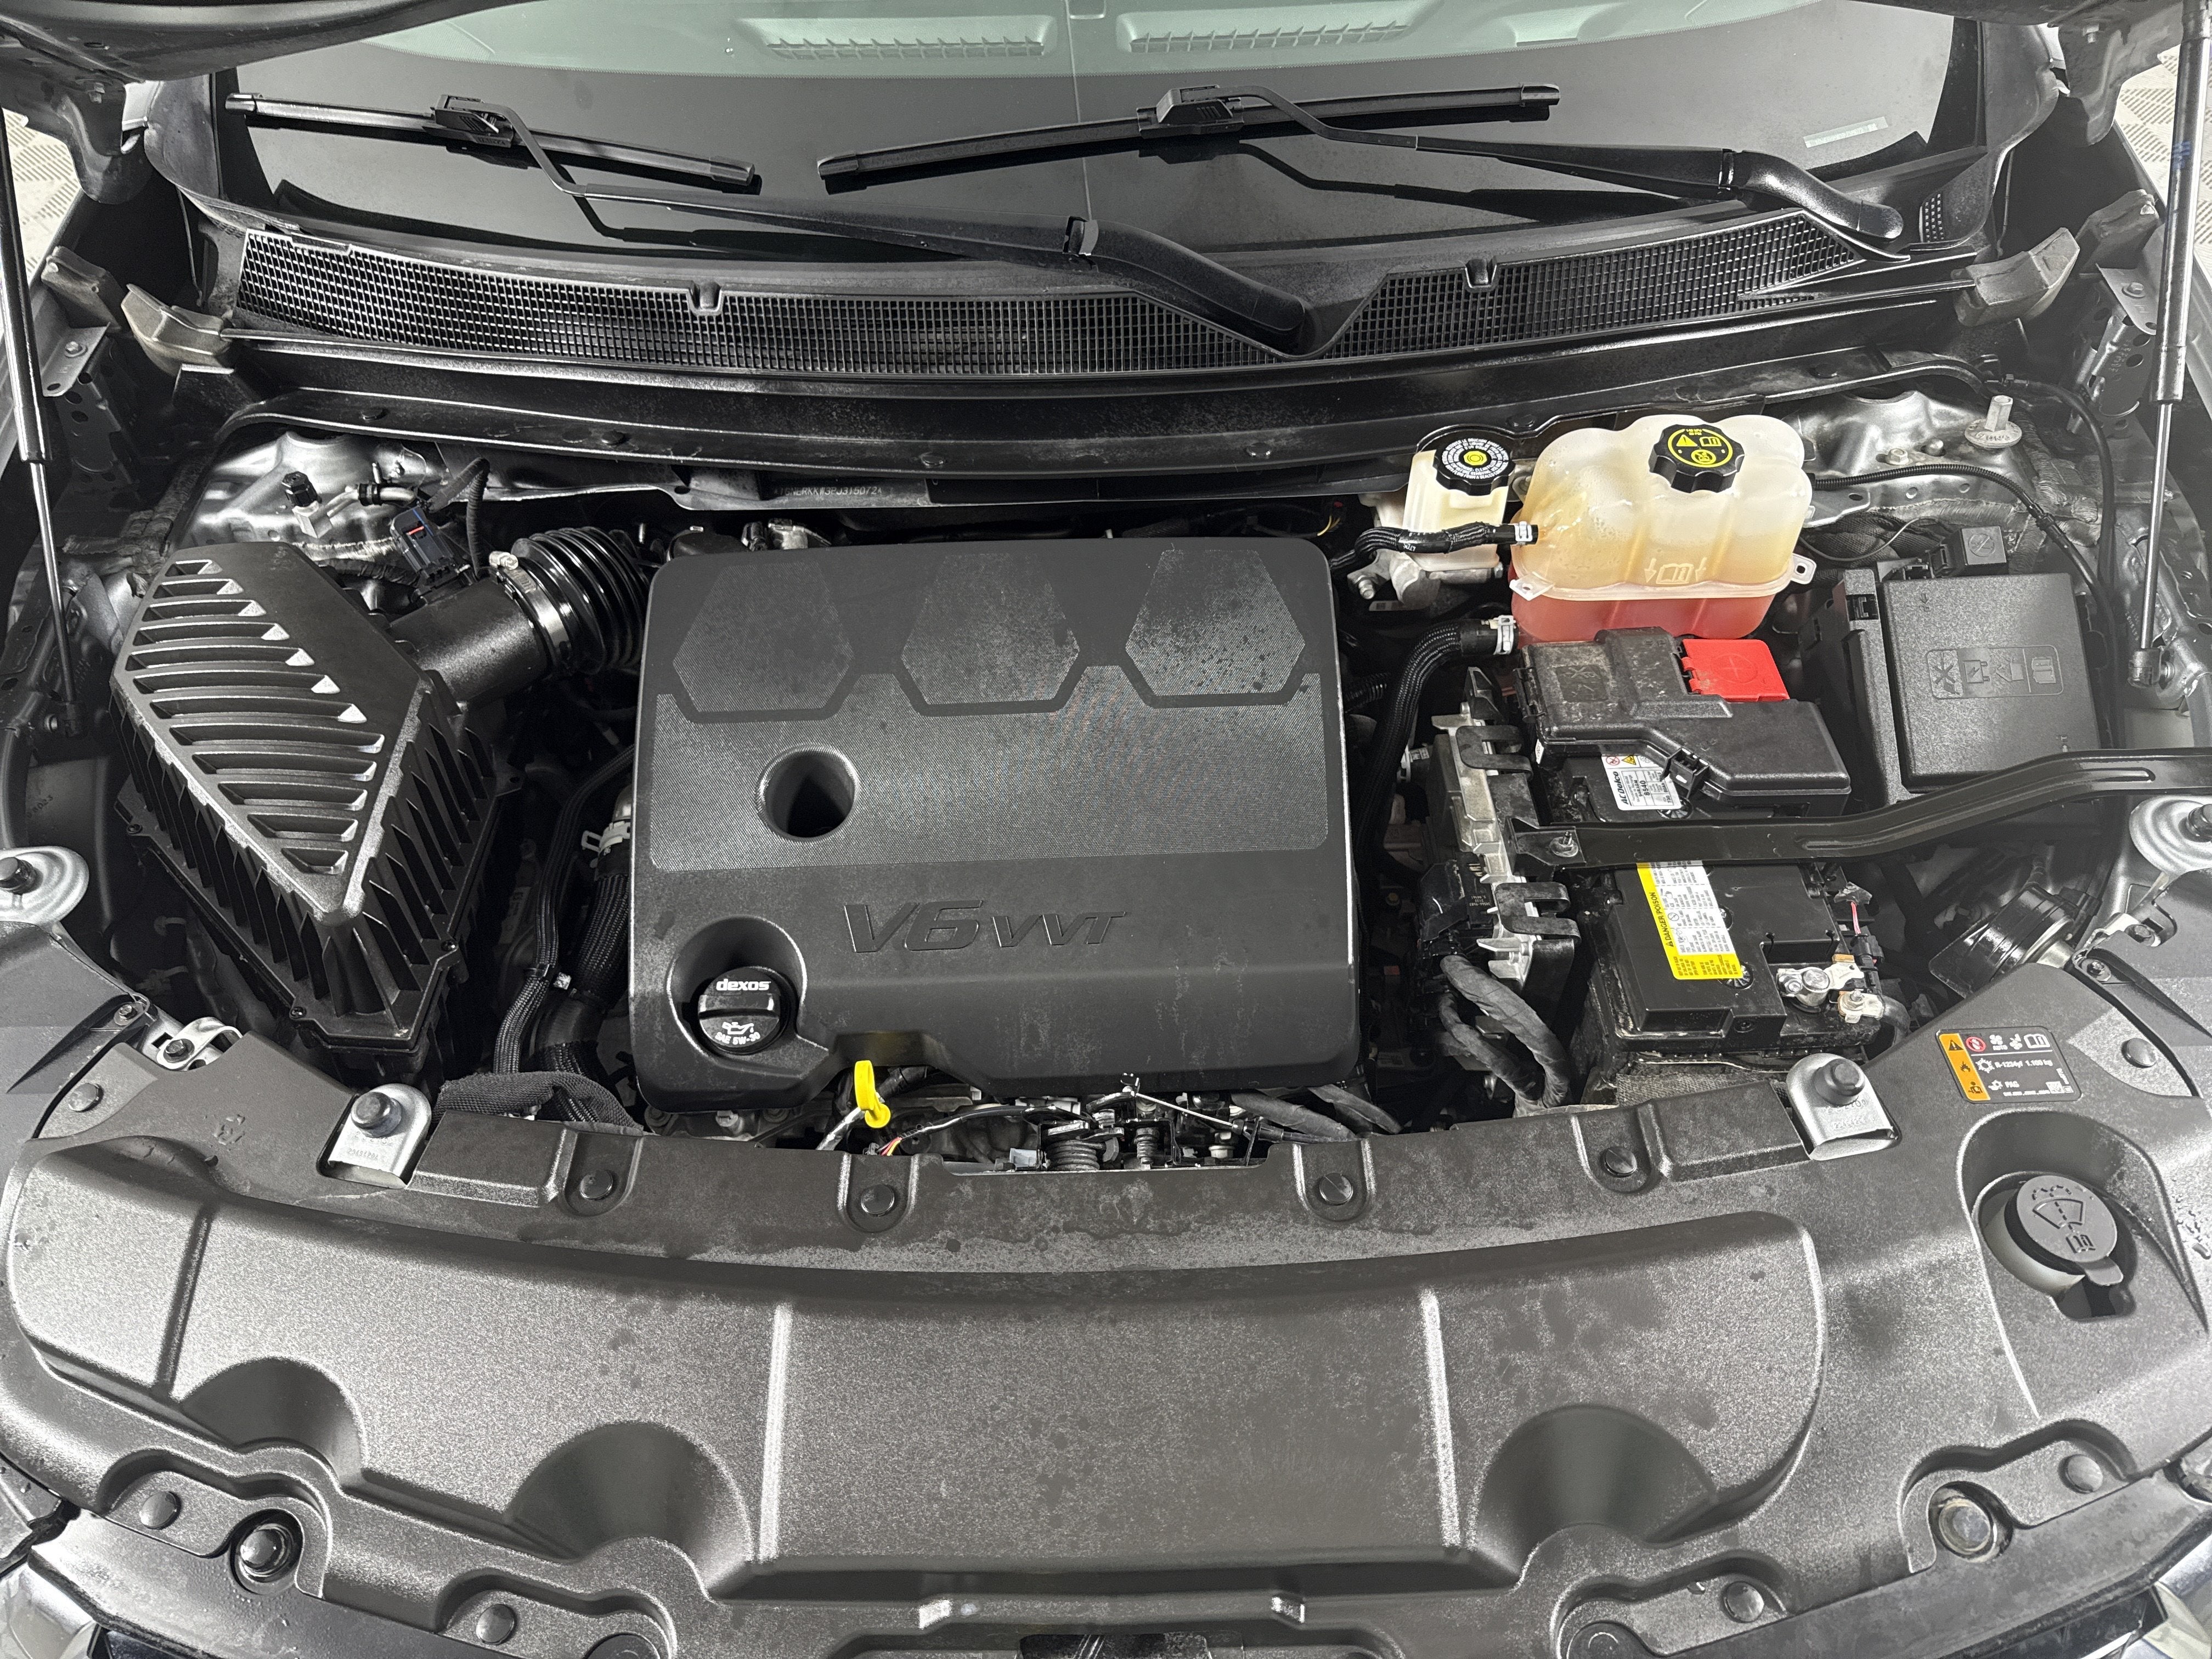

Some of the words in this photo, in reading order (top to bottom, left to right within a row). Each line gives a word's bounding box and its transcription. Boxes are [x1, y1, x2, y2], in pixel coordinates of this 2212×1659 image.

[843, 900, 984, 953] V6
[991, 911, 1127, 949] VVT
[1649, 892, 1673, 941] DANGER/POISON
[716, 978, 770, 991] dexos
[715, 1031, 731, 1044] SAE
